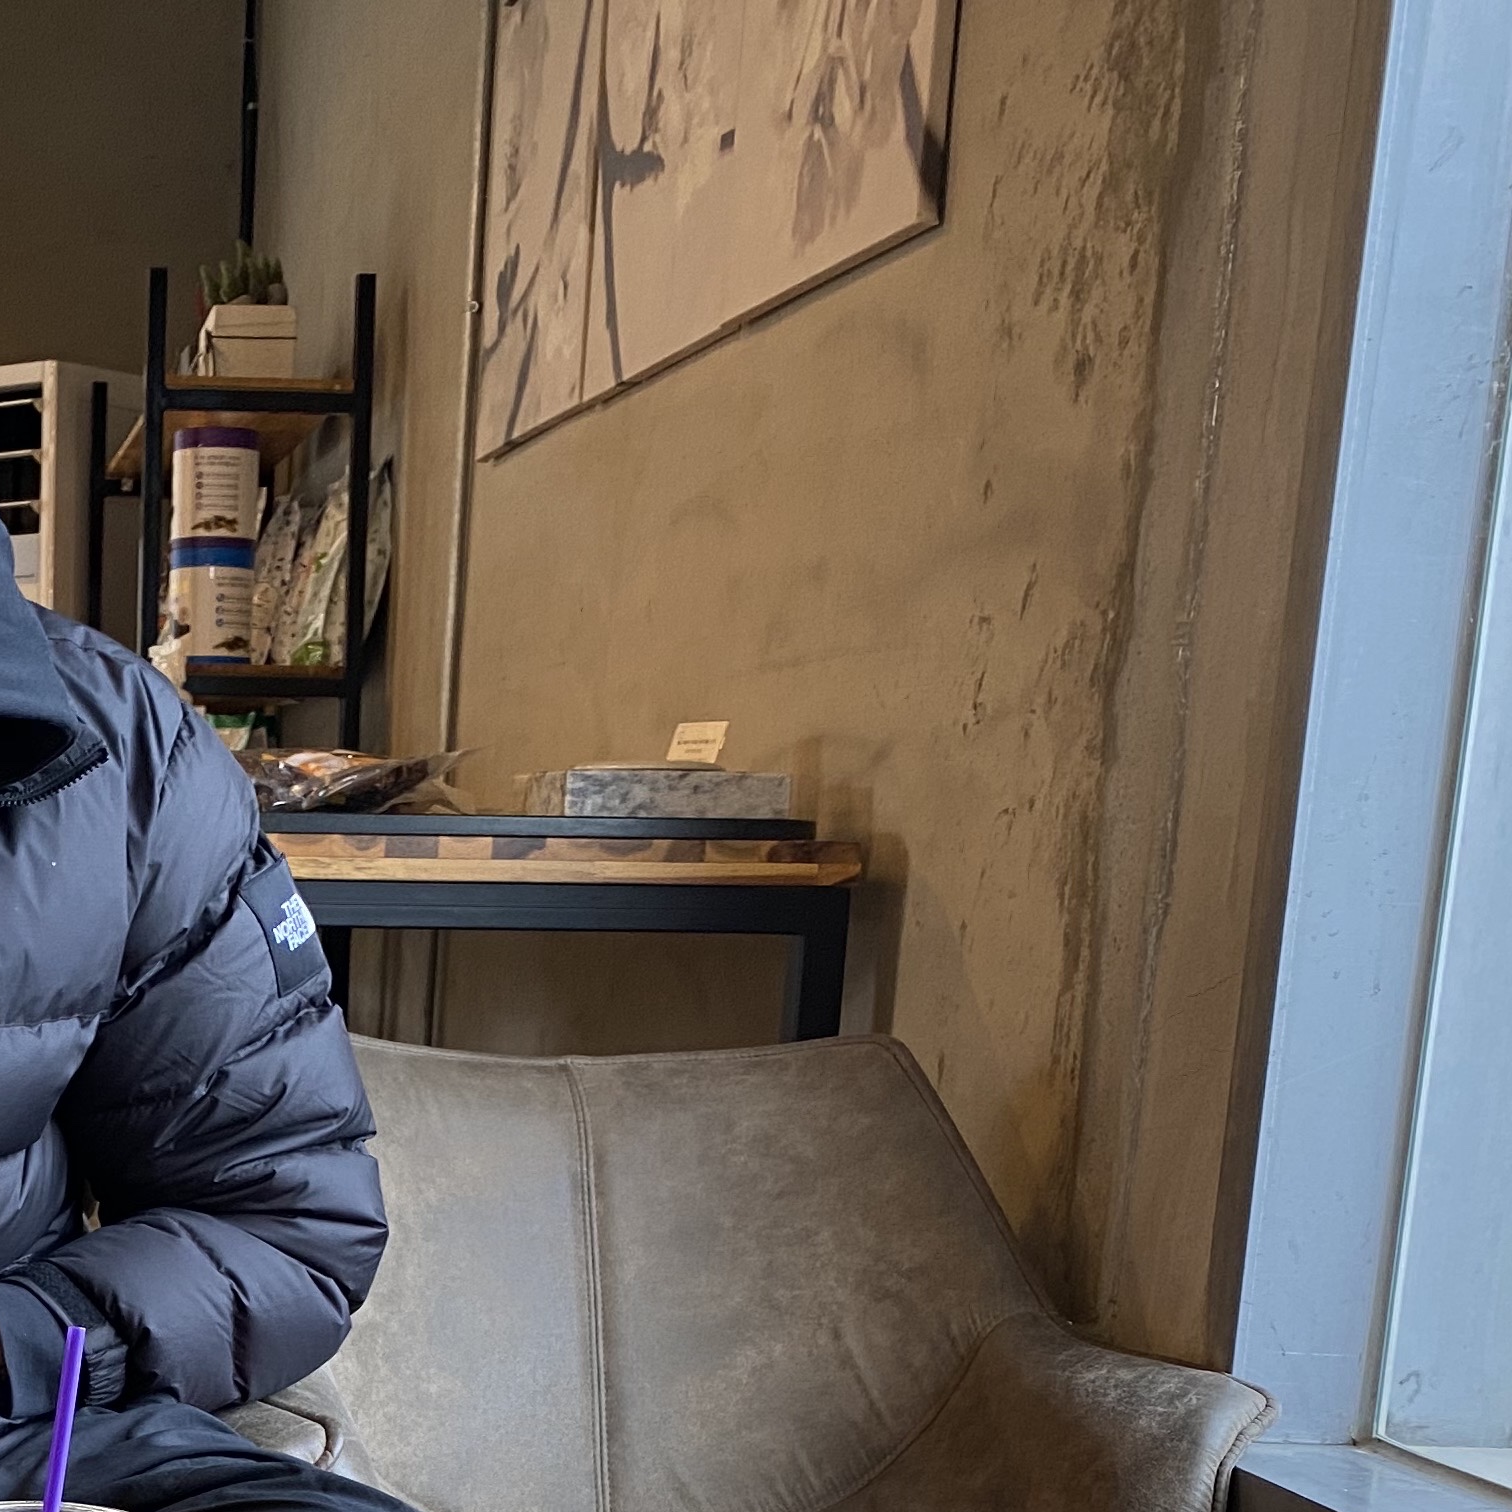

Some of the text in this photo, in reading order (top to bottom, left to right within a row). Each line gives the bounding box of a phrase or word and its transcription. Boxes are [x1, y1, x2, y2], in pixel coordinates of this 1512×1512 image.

[281, 894, 302, 918] THE
[273, 909, 305, 943] NORTH
[287, 922, 310, 951] FACE
